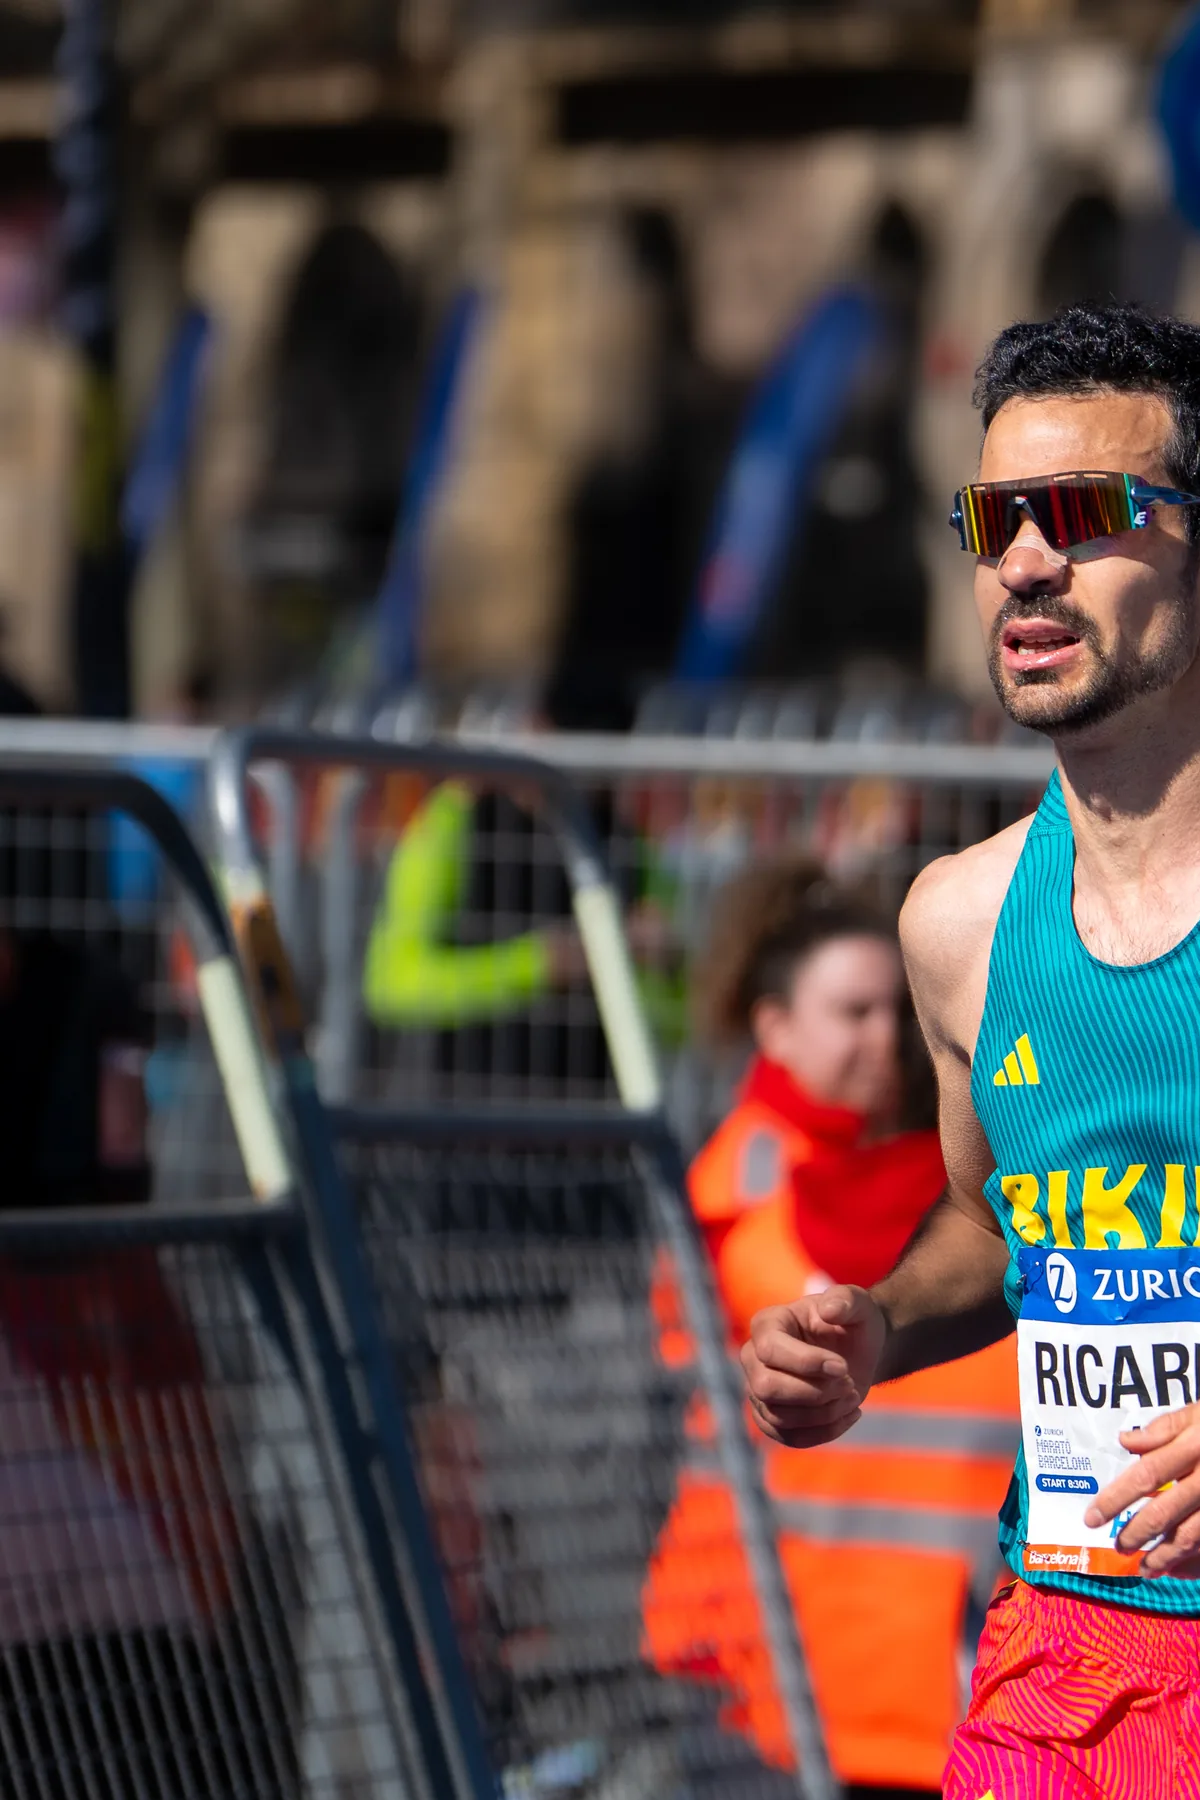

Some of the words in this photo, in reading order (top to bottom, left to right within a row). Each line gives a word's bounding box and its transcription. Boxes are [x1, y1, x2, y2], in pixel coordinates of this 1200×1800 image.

[1043, 1428, 1064, 1436] ZURICH
[1038, 1454, 1092, 1471] BARCELONA
[1041, 1478, 1066, 1488] START
[1068, 1479, 1091, 1490] 8:30h
[1029, 1550, 1079, 1565] Barcelona
